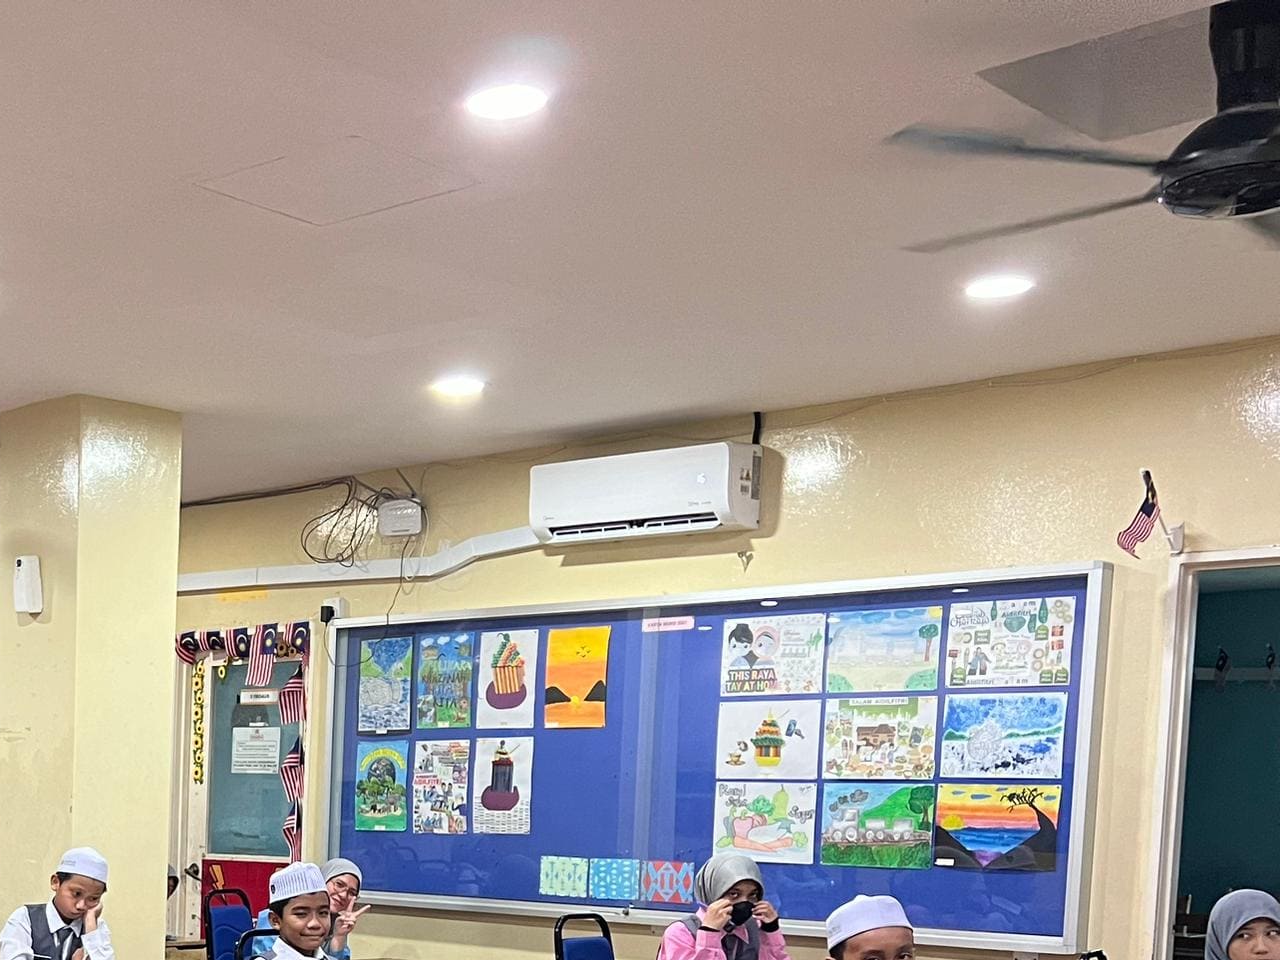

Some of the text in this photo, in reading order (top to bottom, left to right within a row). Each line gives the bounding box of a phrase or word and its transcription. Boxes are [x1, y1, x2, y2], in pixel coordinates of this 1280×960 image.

[729, 669, 776, 681] THIS RAYA
[744, 681, 756, 691] AT
